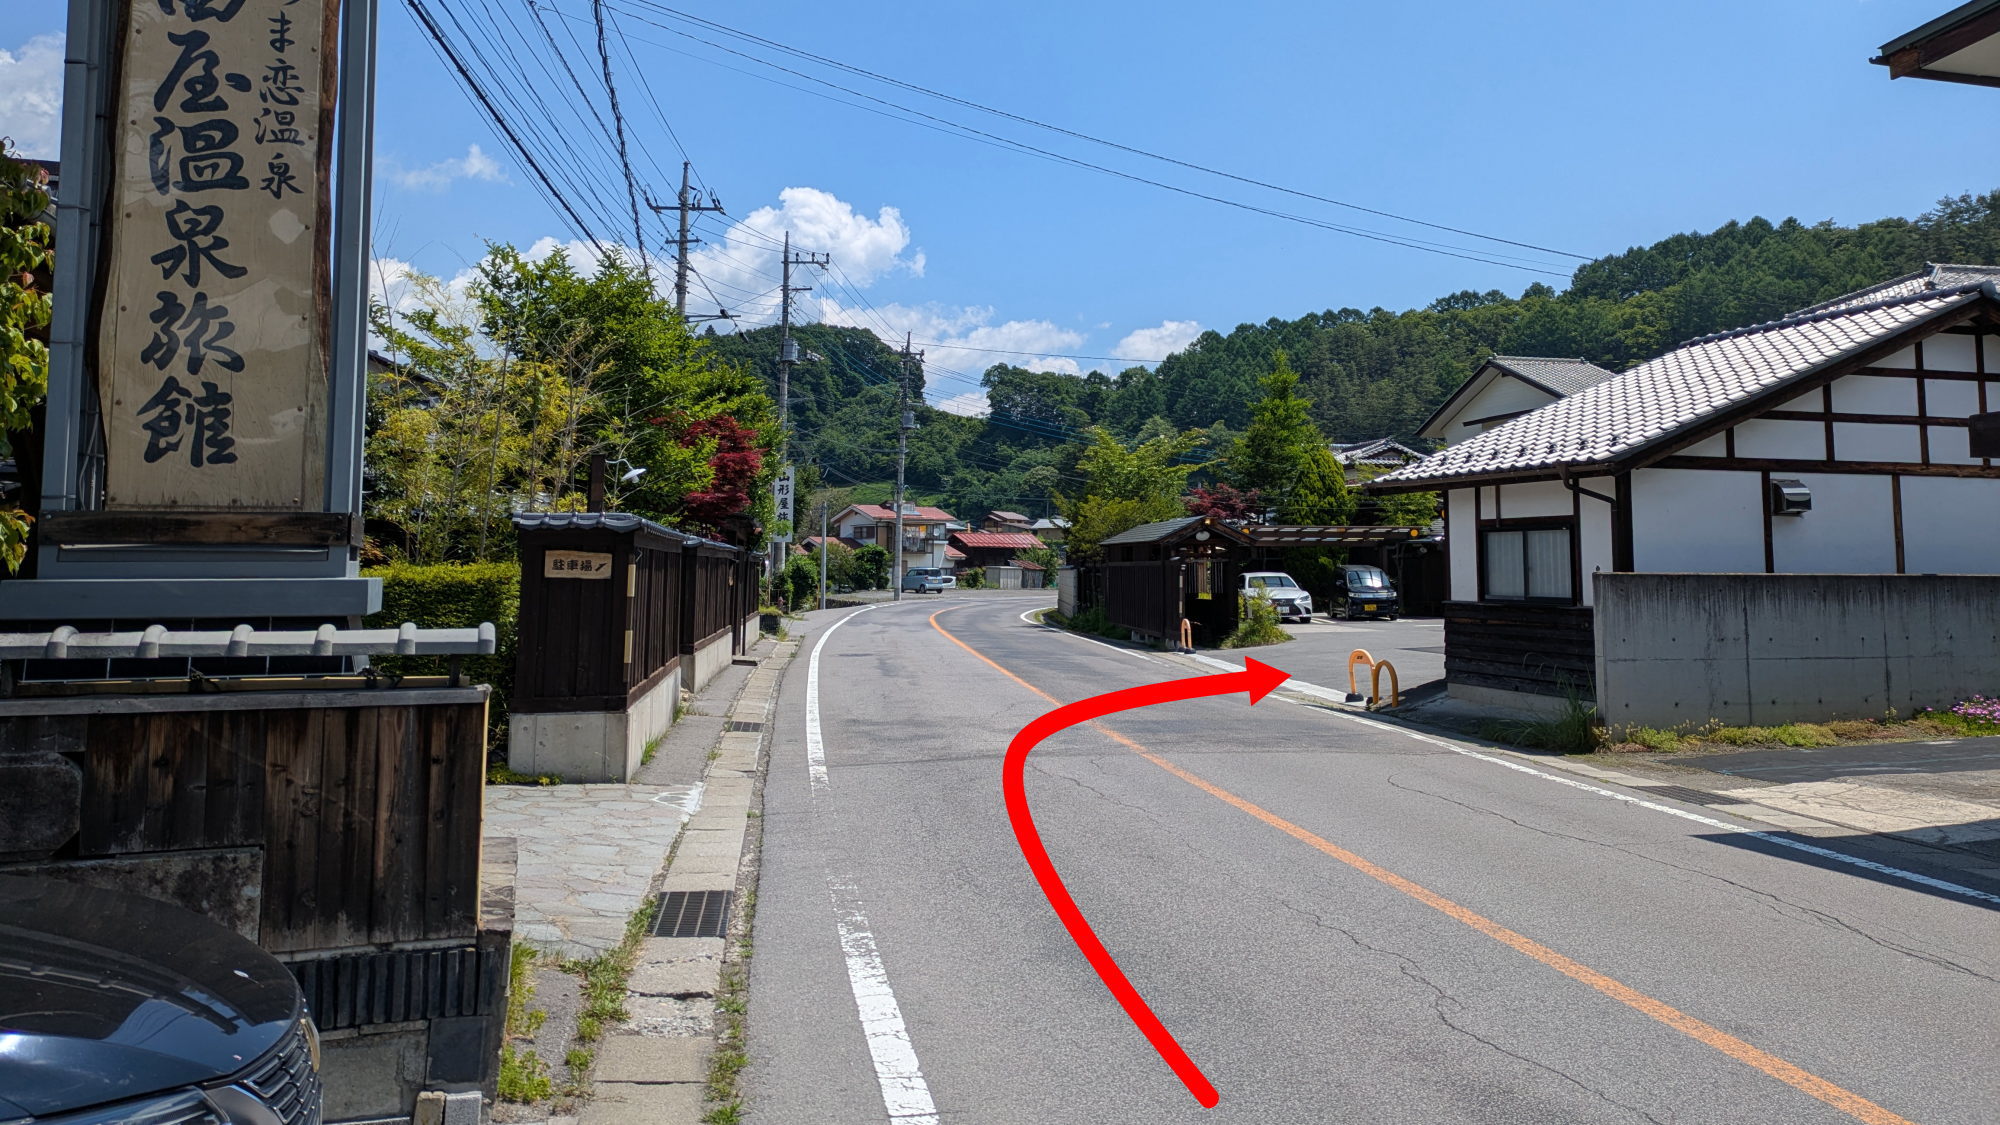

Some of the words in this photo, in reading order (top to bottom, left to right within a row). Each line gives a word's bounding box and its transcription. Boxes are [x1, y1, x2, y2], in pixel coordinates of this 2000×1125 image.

[254, 0, 306, 201] ま恋温泉
[551, 556, 593, 573] 駐車場
